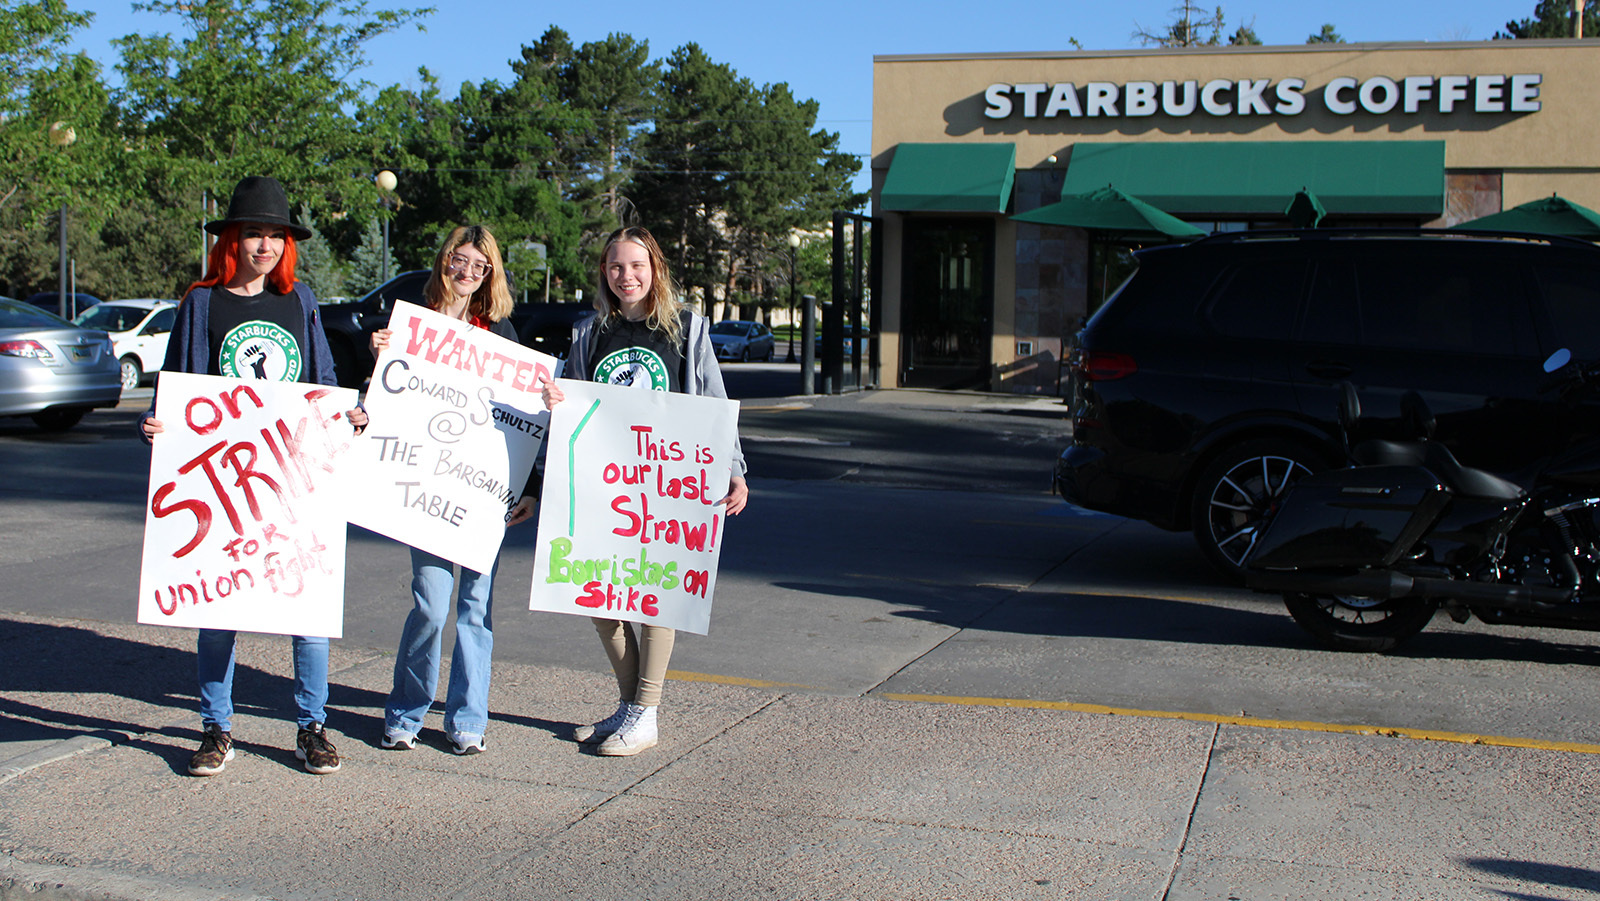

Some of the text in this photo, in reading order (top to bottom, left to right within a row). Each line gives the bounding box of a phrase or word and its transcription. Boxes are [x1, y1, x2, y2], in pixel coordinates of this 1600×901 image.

[984, 74, 1542, 119] STARBUCKS COFFEE
[227, 325, 290, 349] STARBUCKS
[406, 316, 551, 393] WANTED
[602, 351, 660, 373] STARBUCKS
[381, 359, 468, 408] COWARD
[427, 410, 467, 444] @
[630, 425, 714, 464] This is
[371, 436, 423, 466] THE
[152, 389, 350, 559] STRIKE
[602, 462, 712, 505] our last
[395, 481, 467, 527] TABLE
[611, 493, 719, 552] Straw!
[575, 581, 659, 617] Stike
[684, 569, 709, 599] on
